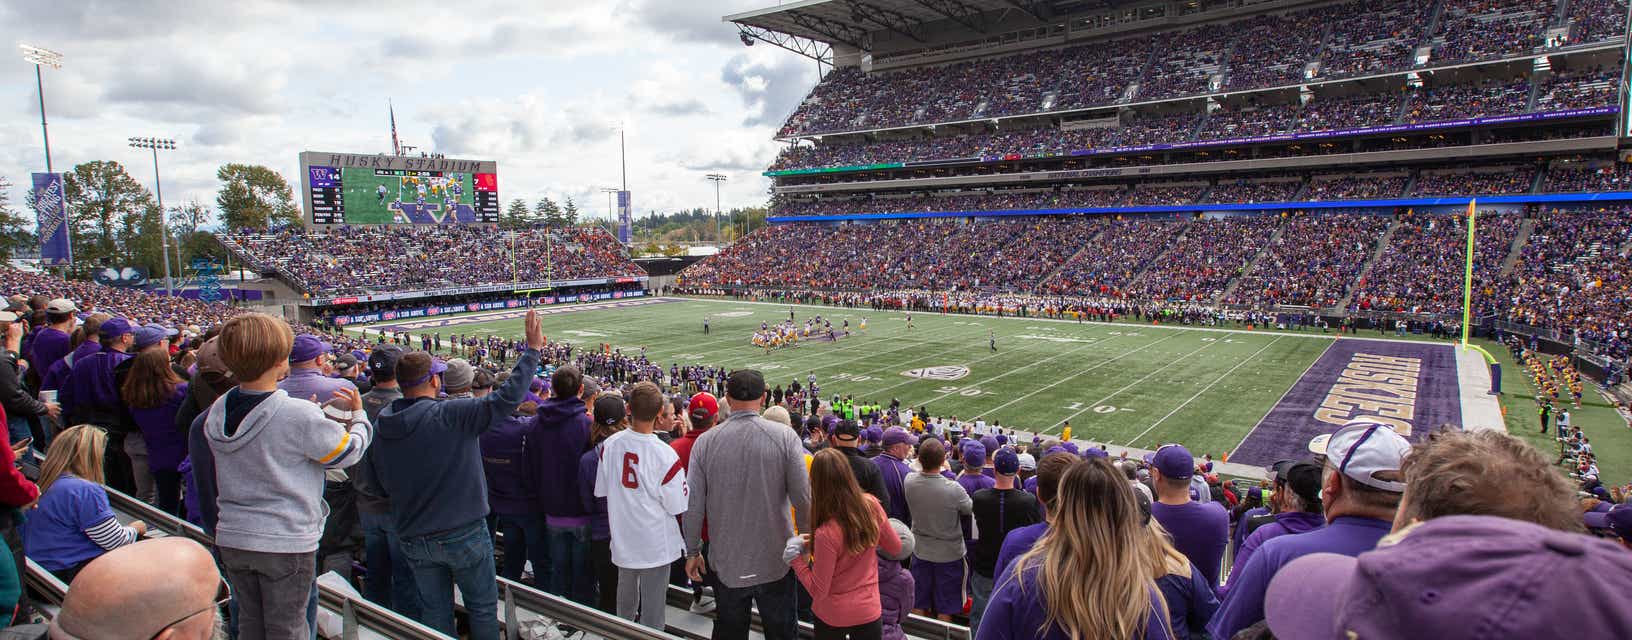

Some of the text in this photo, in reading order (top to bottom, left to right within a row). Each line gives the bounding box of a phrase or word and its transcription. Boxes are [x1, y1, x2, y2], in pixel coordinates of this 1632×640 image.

[311, 168, 328, 180] W
[330, 155, 481, 171] HUSKY STADIUM
[1313, 353, 1421, 437] HUSKIES
[621, 452, 639, 489] 6
